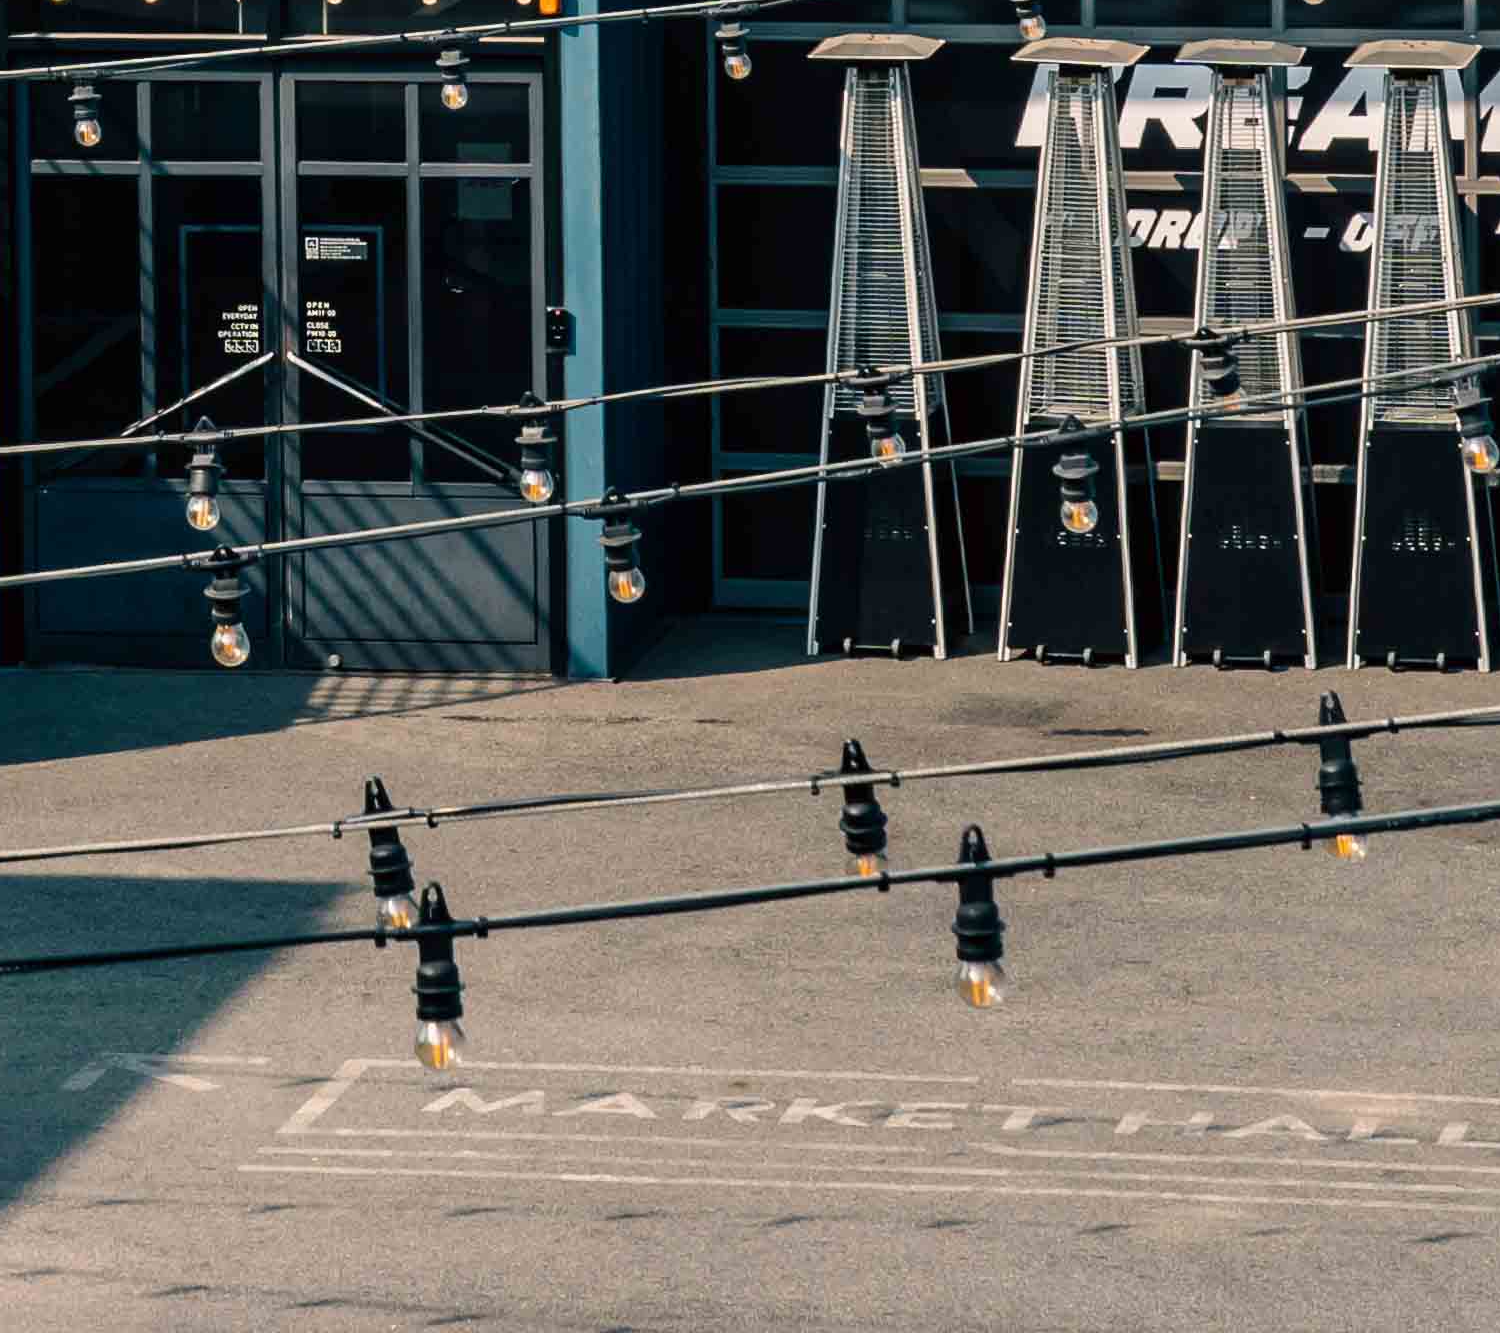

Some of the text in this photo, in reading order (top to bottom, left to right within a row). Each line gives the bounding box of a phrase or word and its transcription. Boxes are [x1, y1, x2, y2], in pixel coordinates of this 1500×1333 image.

[306, 301, 330, 309] OPEN
[222, 312, 259, 320] EVERYDAY
[230, 322, 248, 330] CCTV
[306, 321, 329, 330] CLOSE
[217, 330, 260, 338] OPERATION
[420, 1087, 1090, 1134] MARKET
